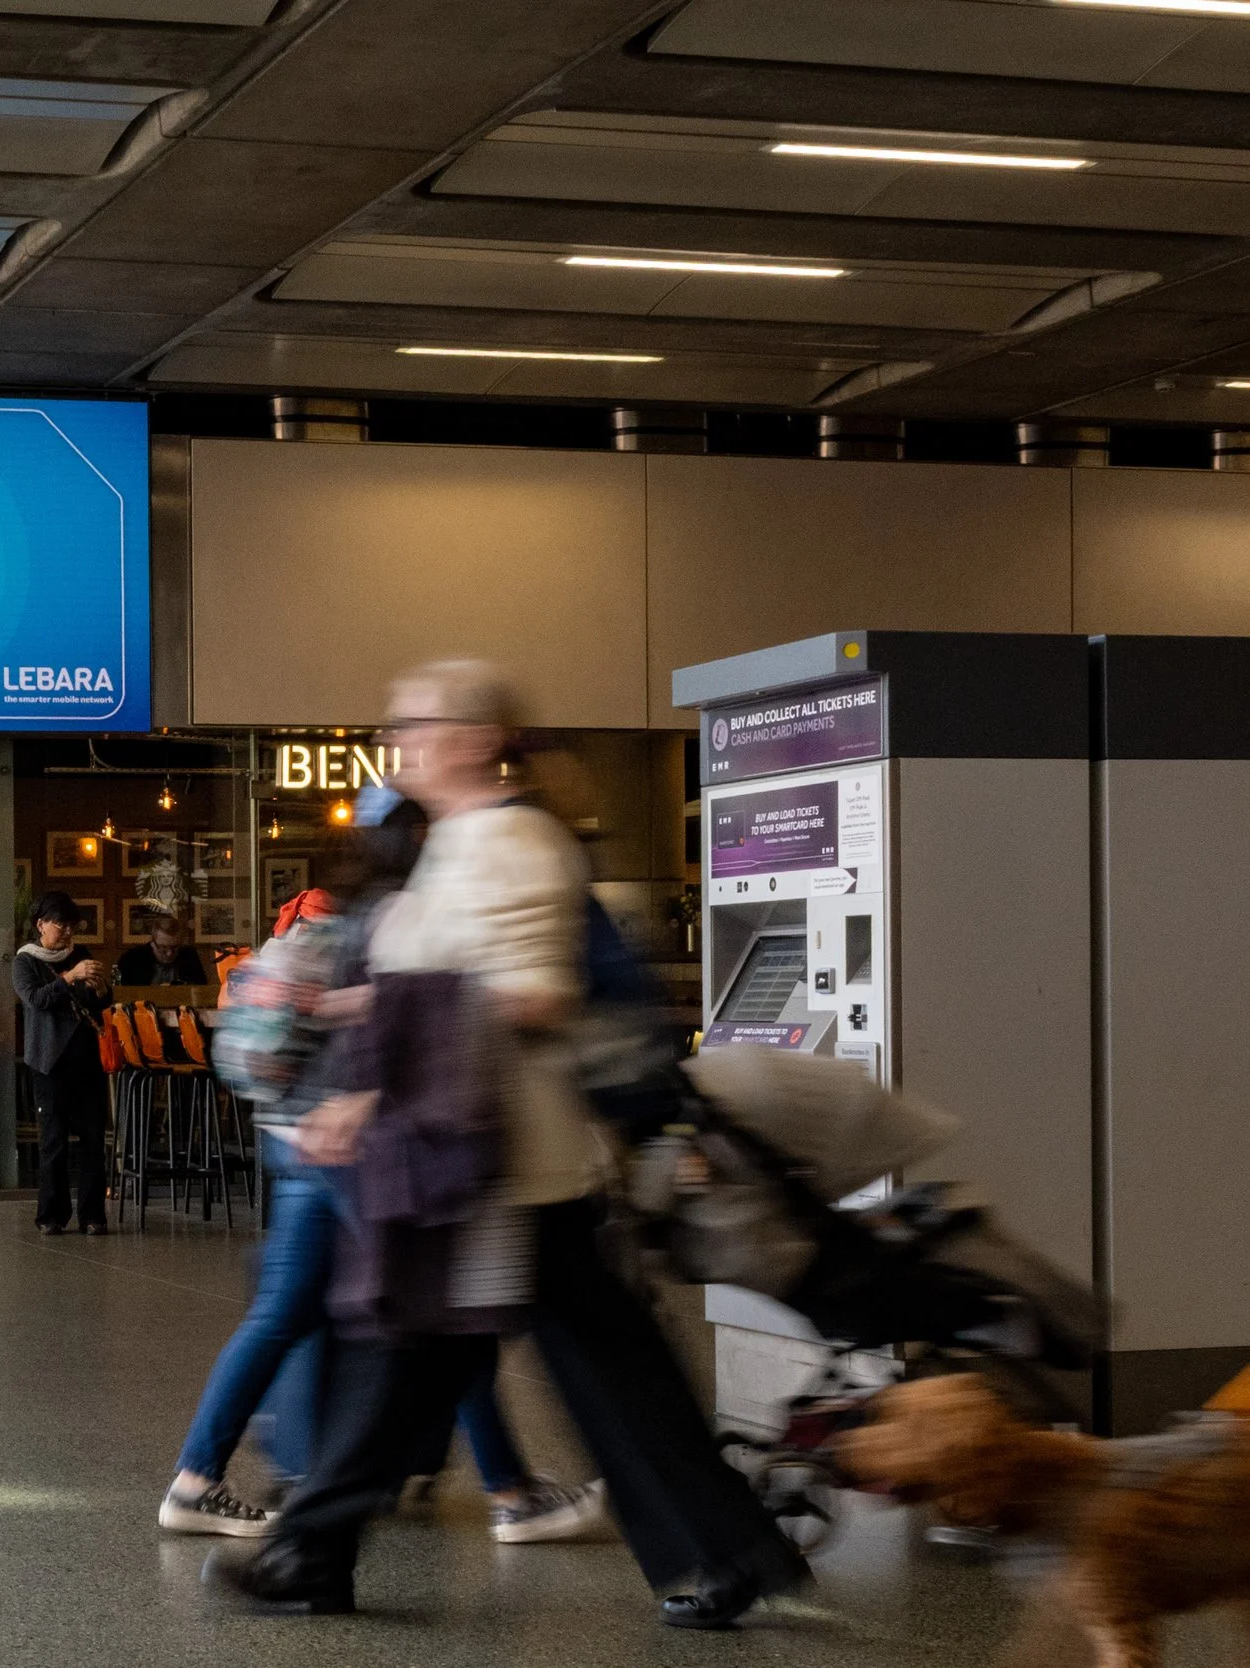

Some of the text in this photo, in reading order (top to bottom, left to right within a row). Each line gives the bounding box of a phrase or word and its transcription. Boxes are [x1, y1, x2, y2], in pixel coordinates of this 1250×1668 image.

[3, 666, 114, 691] LEBARA
[4, 694, 18, 703] the
[52, 695, 79, 704] mobile
[80, 695, 114, 704] network
[731, 690, 877, 730] BUY AND COLLECT ALL TICKETS HERE
[731, 715, 835, 747] CASH AND CARD PAYMENTS
[712, 761, 730, 772] EMR
[755, 805, 820, 823] BUY AND LOAD TICKETS
[751, 817, 825, 835] TO YOUR SMARTCARD HERE
